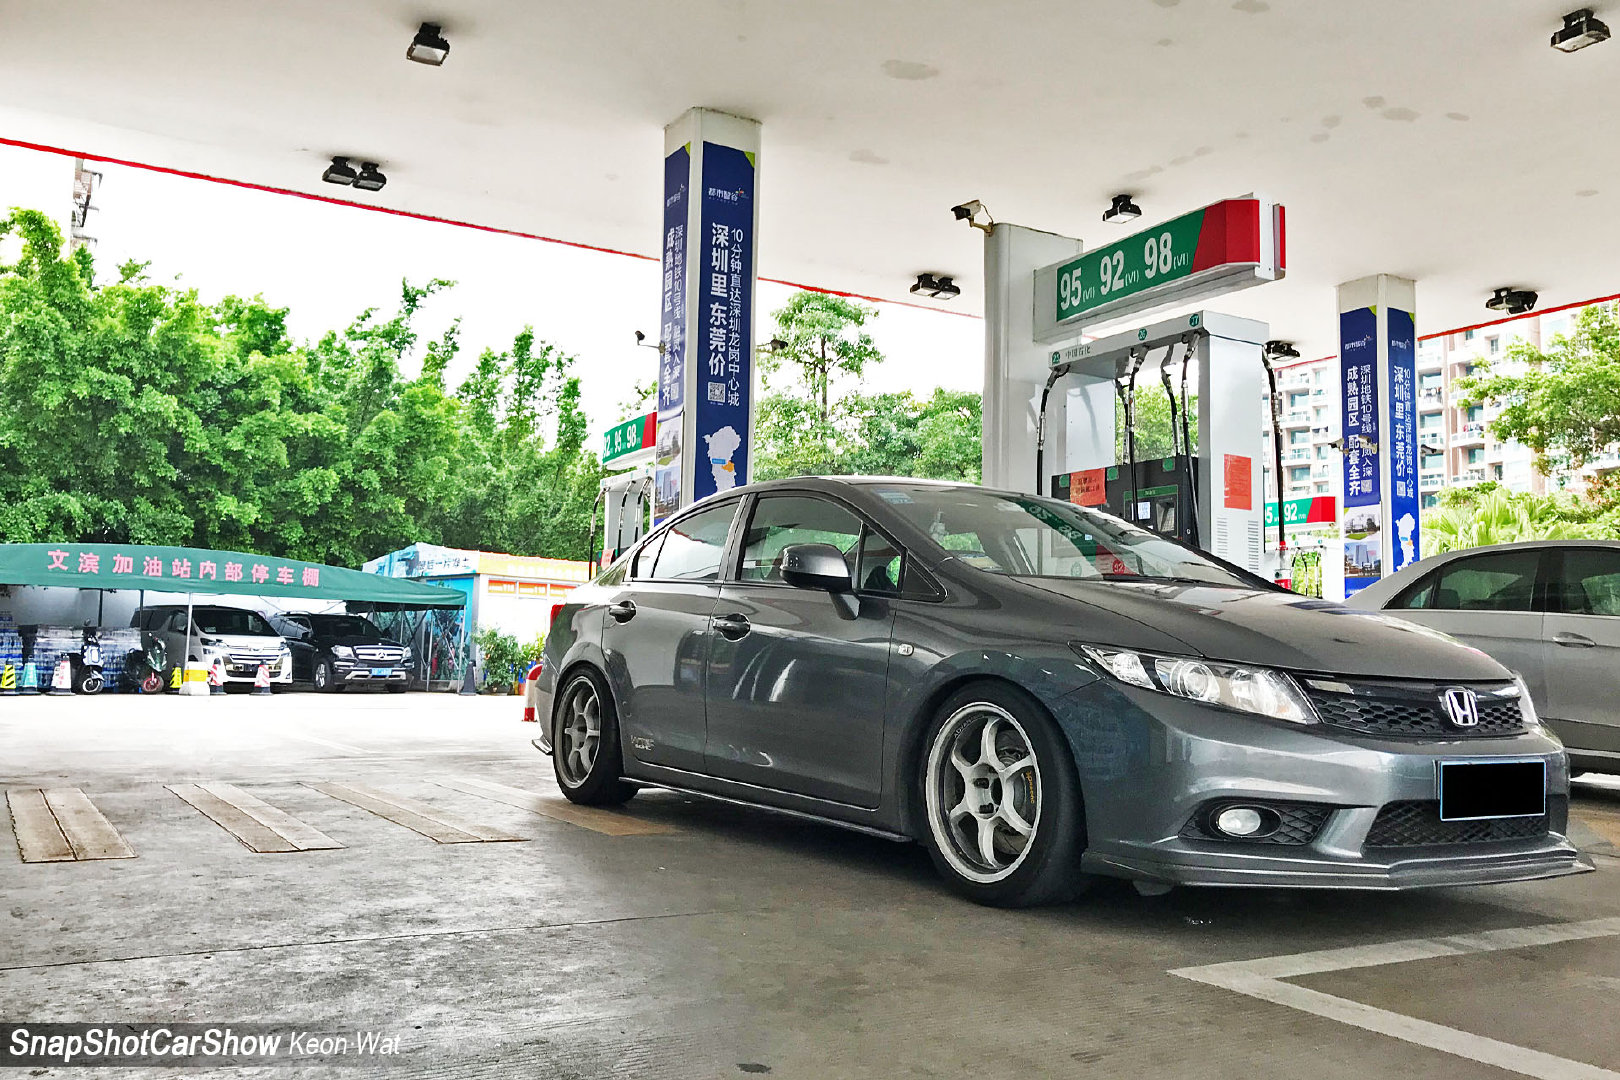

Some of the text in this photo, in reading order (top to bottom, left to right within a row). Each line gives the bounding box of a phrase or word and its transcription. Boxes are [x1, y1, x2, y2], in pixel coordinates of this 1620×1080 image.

[710, 221, 729, 298] 深圳里
[1060, 266, 1082, 311] 95
[1100, 250, 1125, 296] 92
[1144, 232, 1172, 279] 98
[708, 302, 728, 377] 东莞价
[728, 227, 743, 407] 10分钟直达深圳龙岗中心城
[627, 423, 637, 449] 98
[1347, 365, 1361, 497] 成熟园区 配套全齐
[1360, 364, 1372, 434] 深圳地铁10号线
[1393, 365, 1406, 478] 深圳里 东莞价
[1284, 502, 1298, 522] 92
[47, 549, 320, 587] 文滨加油站内部停车棚
